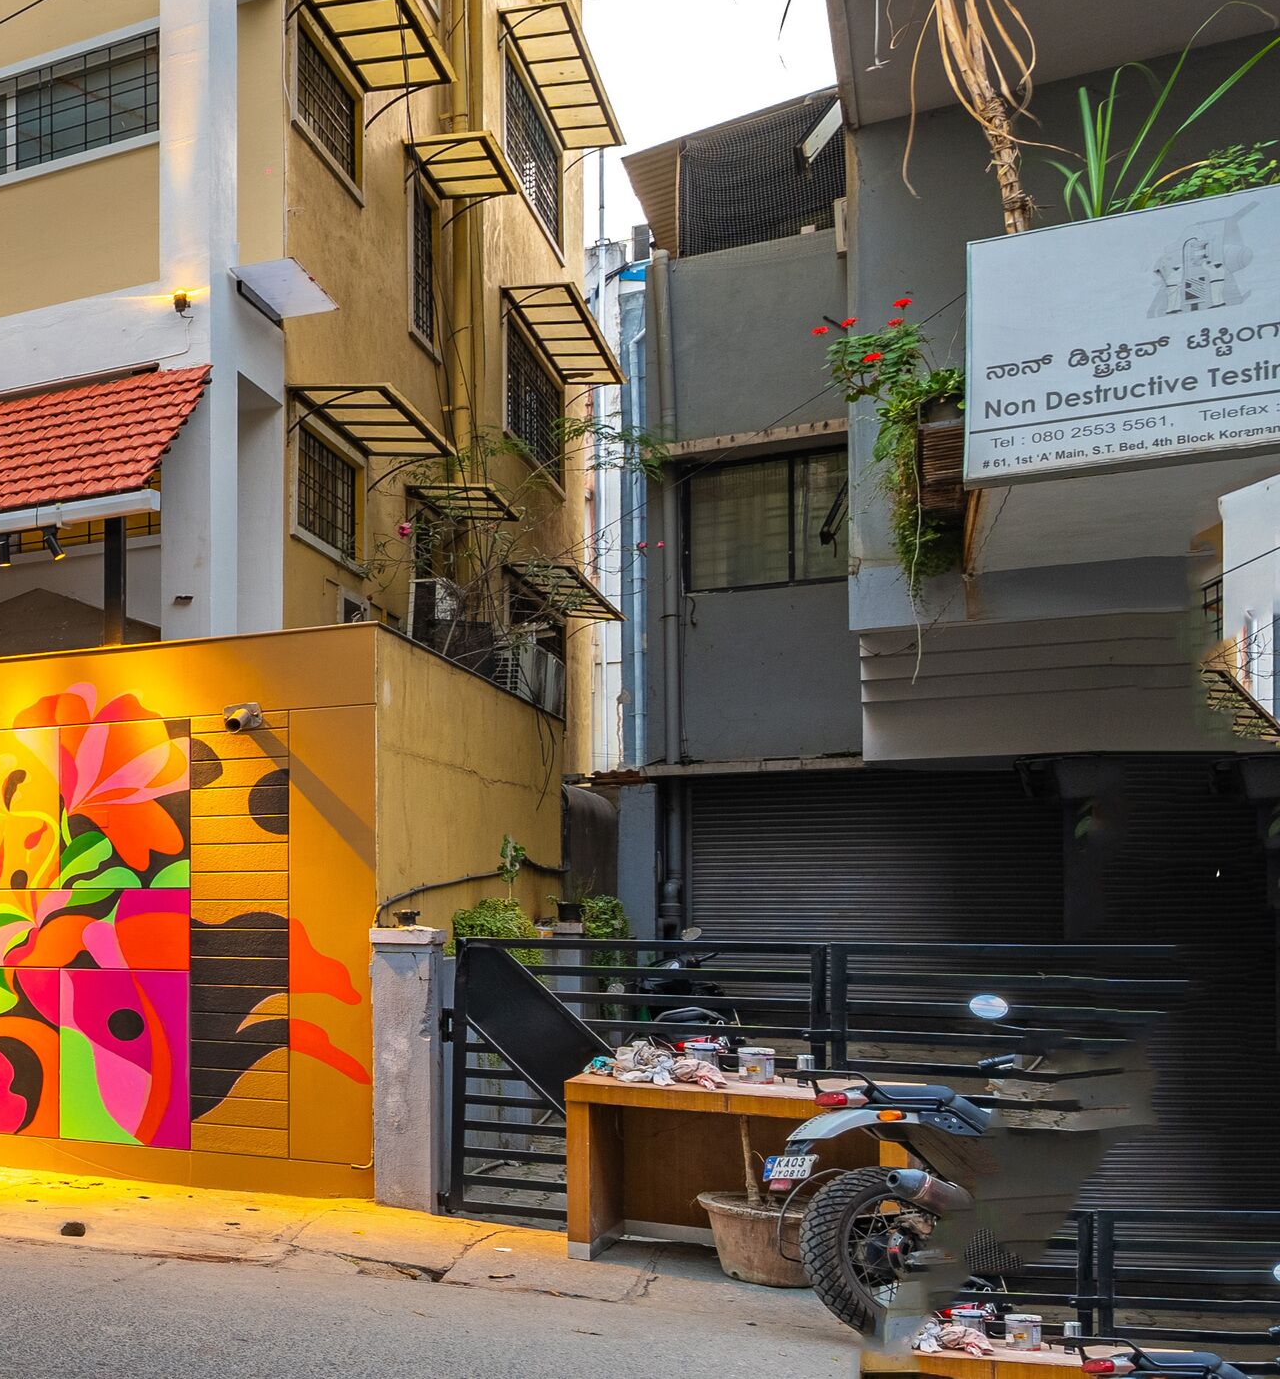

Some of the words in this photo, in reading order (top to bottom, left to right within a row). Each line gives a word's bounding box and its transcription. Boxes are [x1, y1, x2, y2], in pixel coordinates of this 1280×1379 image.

[985, 353, 1054, 381] ನಾನ್
[984, 398, 1036, 420] Non
[1045, 374, 1199, 411] Destructive
[990, 435, 1015, 449] Tel
[1031, 428, 1065, 444] 080
[1070, 422, 1116, 439] 2553
[1122, 414, 1175, 432] 5561,
[1199, 403, 1269, 422] Telefax
[1015, 453, 1033, 465] 1st
[1055, 448, 1089, 461] Main,
[1092, 443, 1115, 456] S.T.
[1119, 439, 1148, 453] Bed,
[1151, 436, 1173, 448] 4th
[1177, 431, 1215, 445] Block
[776, 1157, 806, 1168] KA03
